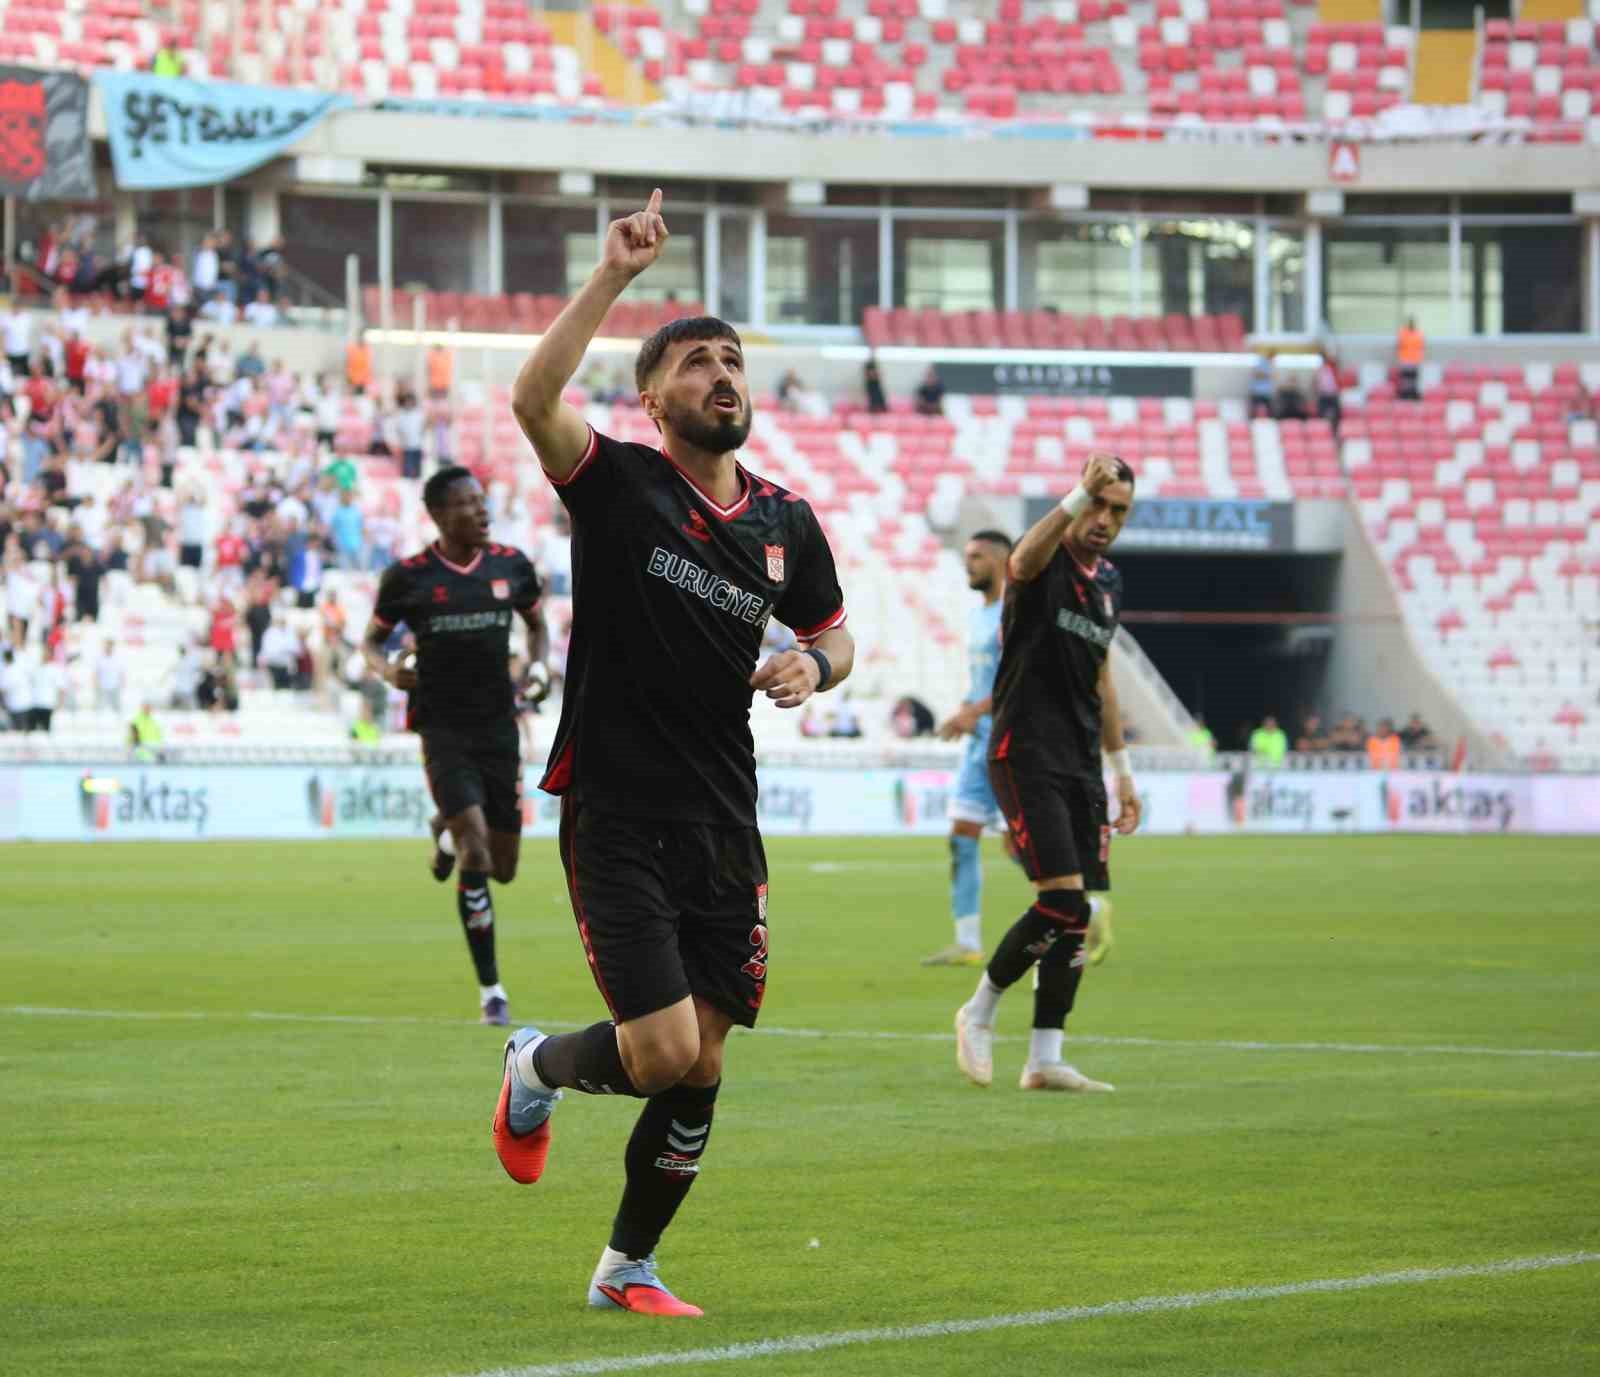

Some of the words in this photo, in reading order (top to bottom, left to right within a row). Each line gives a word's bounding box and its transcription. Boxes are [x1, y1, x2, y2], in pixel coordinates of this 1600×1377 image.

[116, 775, 209, 832] aktaş
[341, 776, 427, 830] aktaş
[1408, 779, 1514, 832] aktaş
